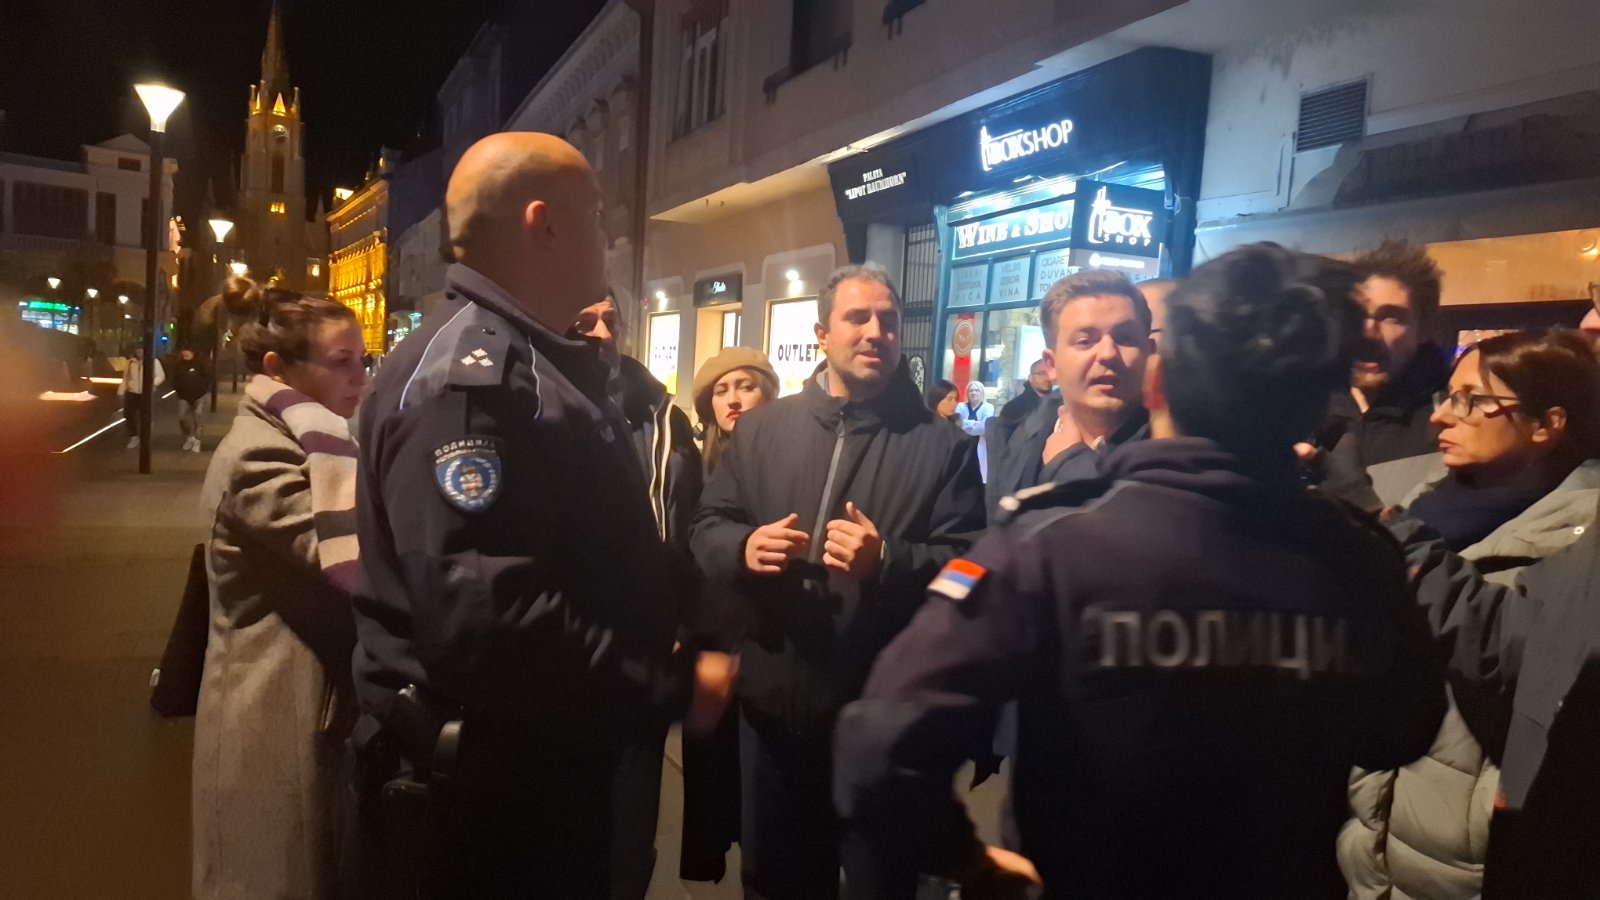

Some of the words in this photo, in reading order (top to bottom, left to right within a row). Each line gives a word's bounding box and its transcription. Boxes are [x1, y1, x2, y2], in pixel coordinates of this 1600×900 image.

[957, 222, 1009, 249] WINE
[1023, 207, 1073, 236] SHO
[1103, 233, 1151, 247] SHOP
[1040, 267, 1073, 280] DUVAN
[999, 287, 1020, 297] VINA
[777, 343, 820, 362] OUTLET
